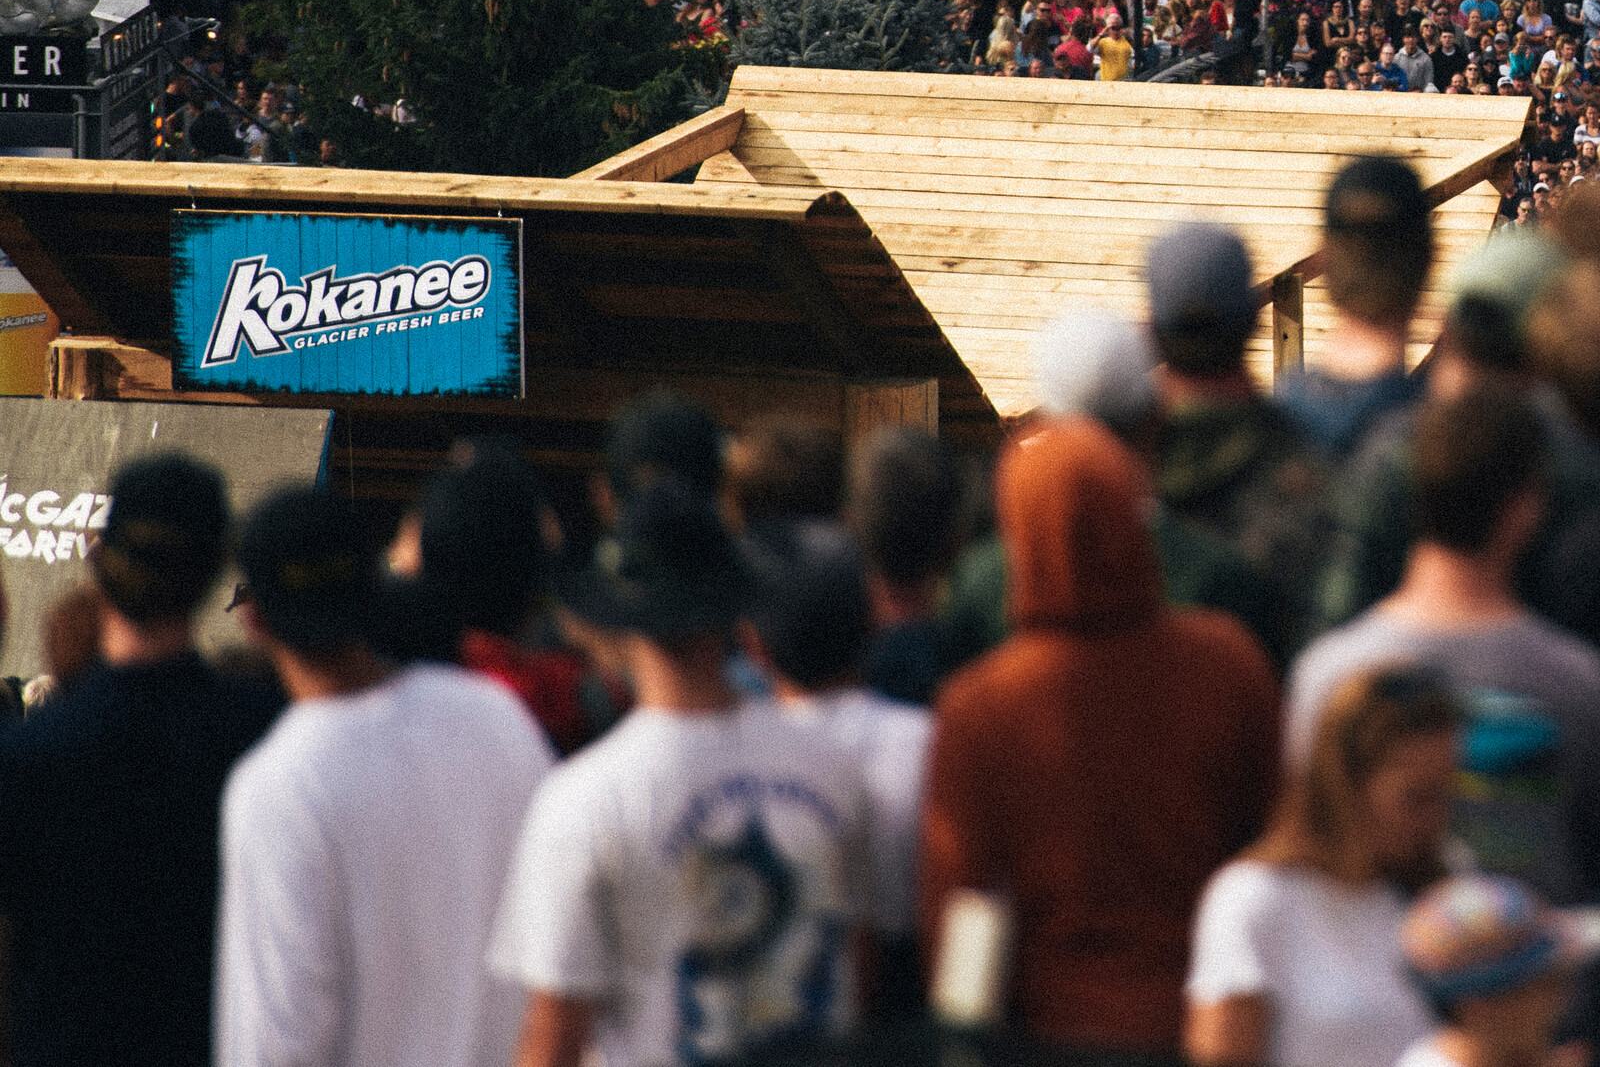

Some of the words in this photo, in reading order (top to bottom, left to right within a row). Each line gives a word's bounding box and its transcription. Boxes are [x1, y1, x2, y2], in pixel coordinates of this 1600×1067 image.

[203, 255, 490, 366] Kokanee
[293, 325, 369, 350] GLACIER
[375, 316, 432, 336] FRESH
[438, 306, 485, 324] BEER
